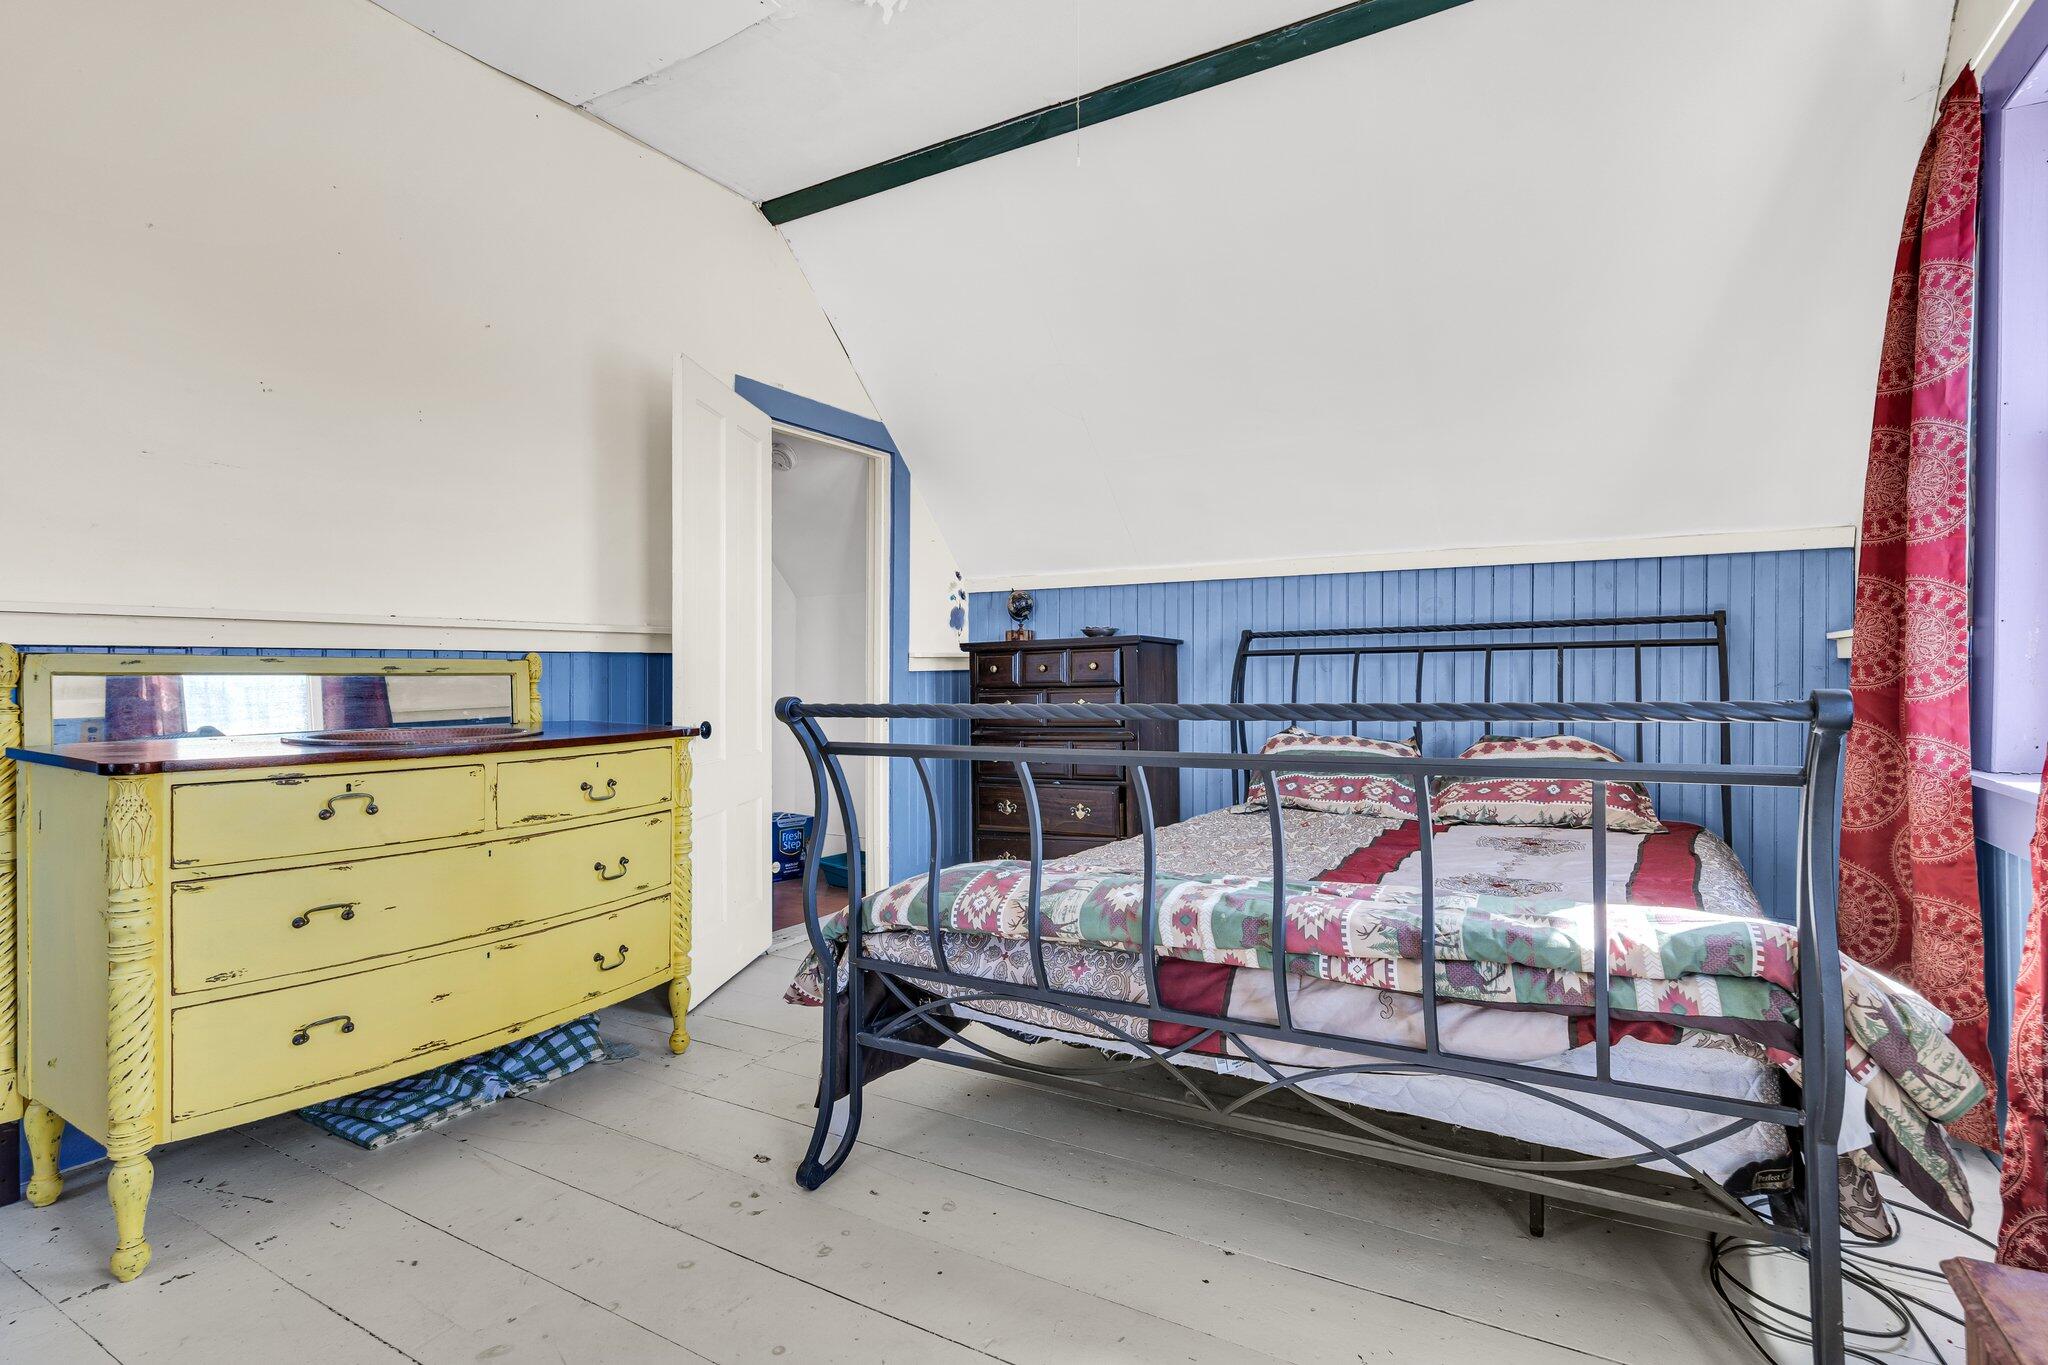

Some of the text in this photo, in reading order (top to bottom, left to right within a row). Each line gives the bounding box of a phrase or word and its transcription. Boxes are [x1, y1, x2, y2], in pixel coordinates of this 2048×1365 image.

[782, 830, 802, 842] Fresh
[783, 840, 801, 850] Step
[1757, 1173, 1780, 1182] Perfect
